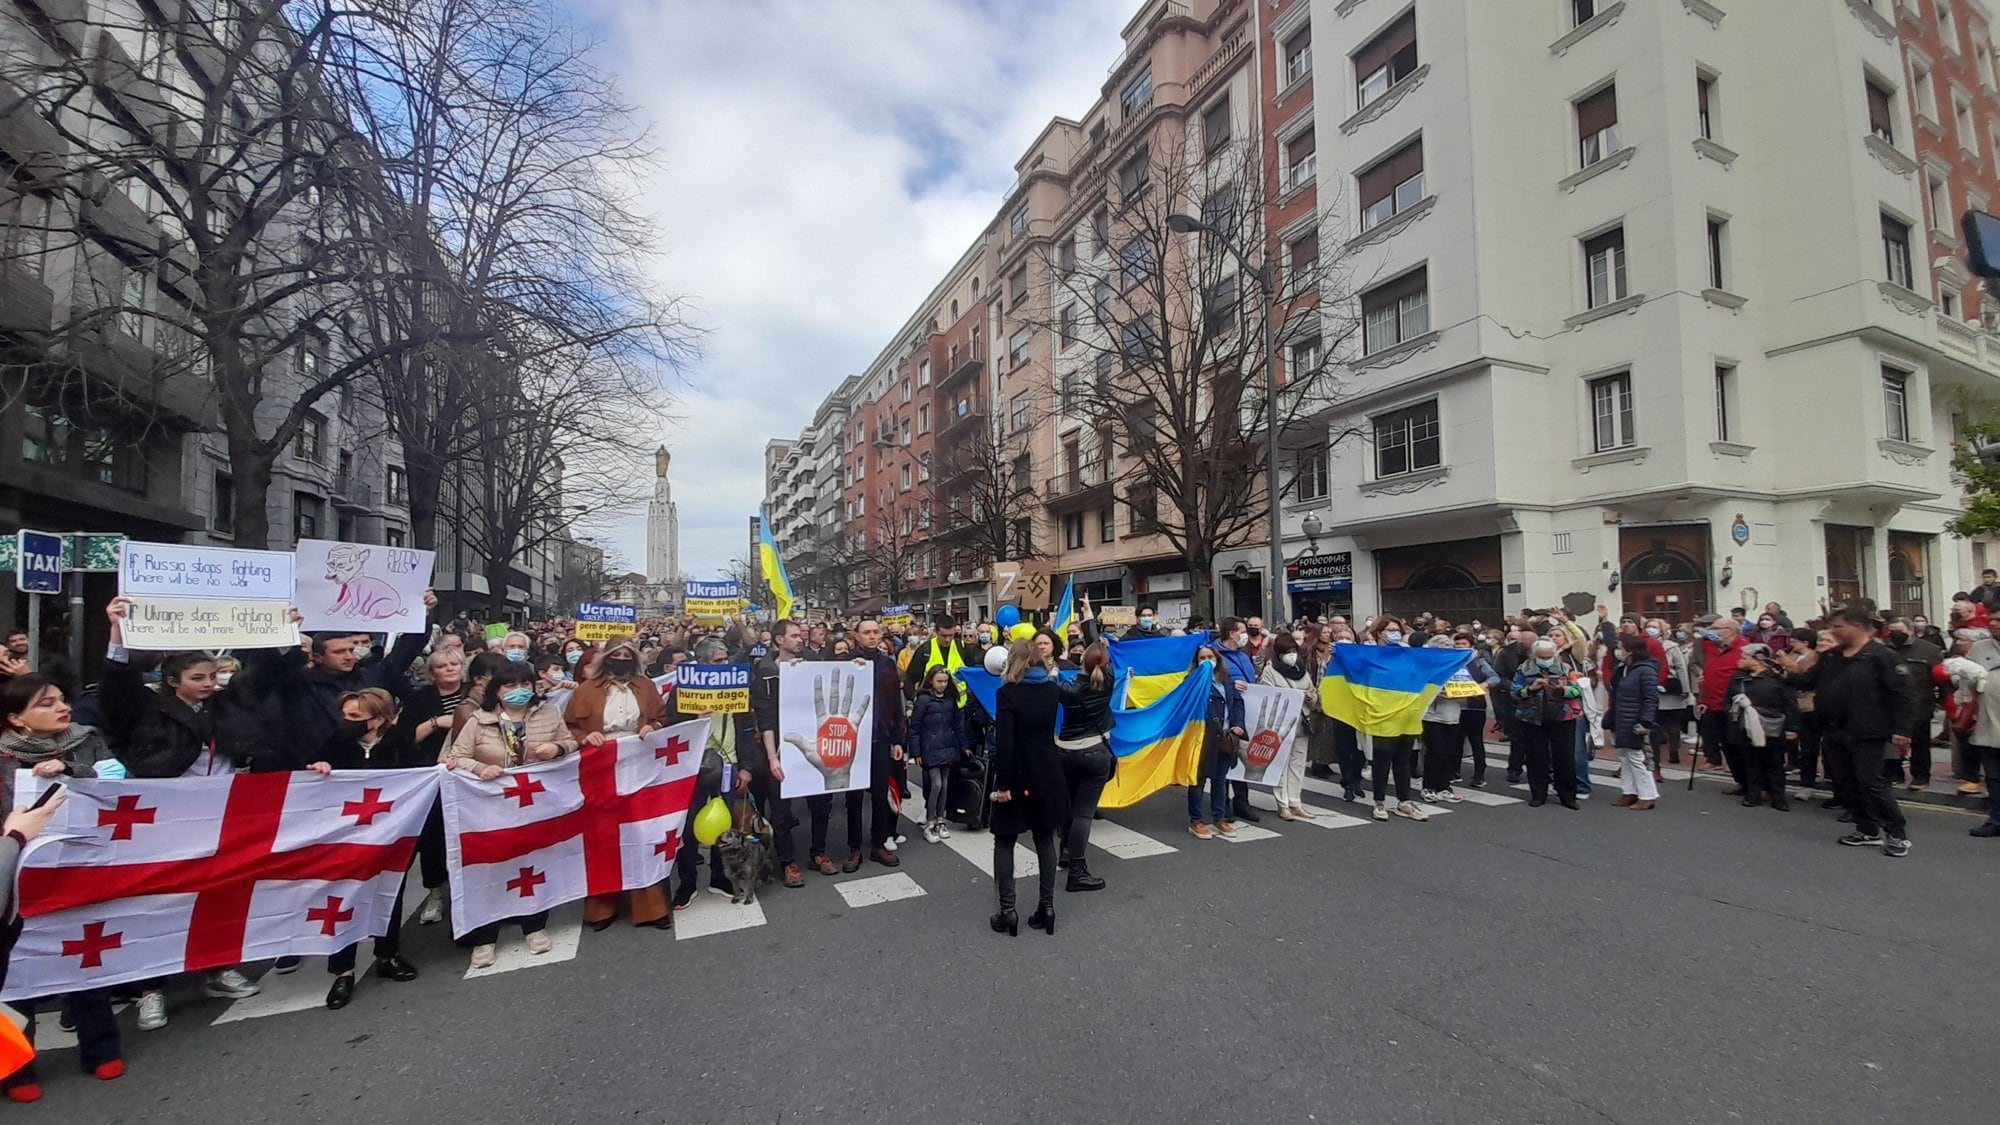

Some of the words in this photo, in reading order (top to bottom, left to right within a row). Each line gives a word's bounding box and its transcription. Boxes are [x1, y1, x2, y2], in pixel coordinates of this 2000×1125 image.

[24, 551, 60, 574] TAXI
[129, 553, 139, 568] If
[145, 554, 186, 572] Russia
[191, 557, 222, 579] stops
[1300, 554, 1346, 567] FOTOCOPIAS
[131, 569, 164, 584] there
[186, 573, 200, 585] be
[1300, 564, 1352, 577] IMPRESIONES
[686, 582, 738, 598] Ukrania
[129, 603, 139, 620] If
[190, 606, 220, 628] stops
[231, 607, 273, 628] fighting
[580, 602, 634, 617] Ucrania
[125, 620, 155, 633] there
[178, 622, 190, 634] be
[213, 626, 235, 634] more
[579, 623, 598, 631] pero
[599, 623, 607, 631] el
[608, 623, 634, 633] peligro
[677, 665, 748, 686] Ukrania
[678, 689, 713, 699] hurrun
[717, 690, 748, 700] dago,
[725, 701, 746, 712] gertu
[828, 723, 848, 737] STOP
[1260, 734, 1276, 746] STOP
[821, 738, 852, 758] PUTIN
[1248, 742, 1275, 761] PUTIN
